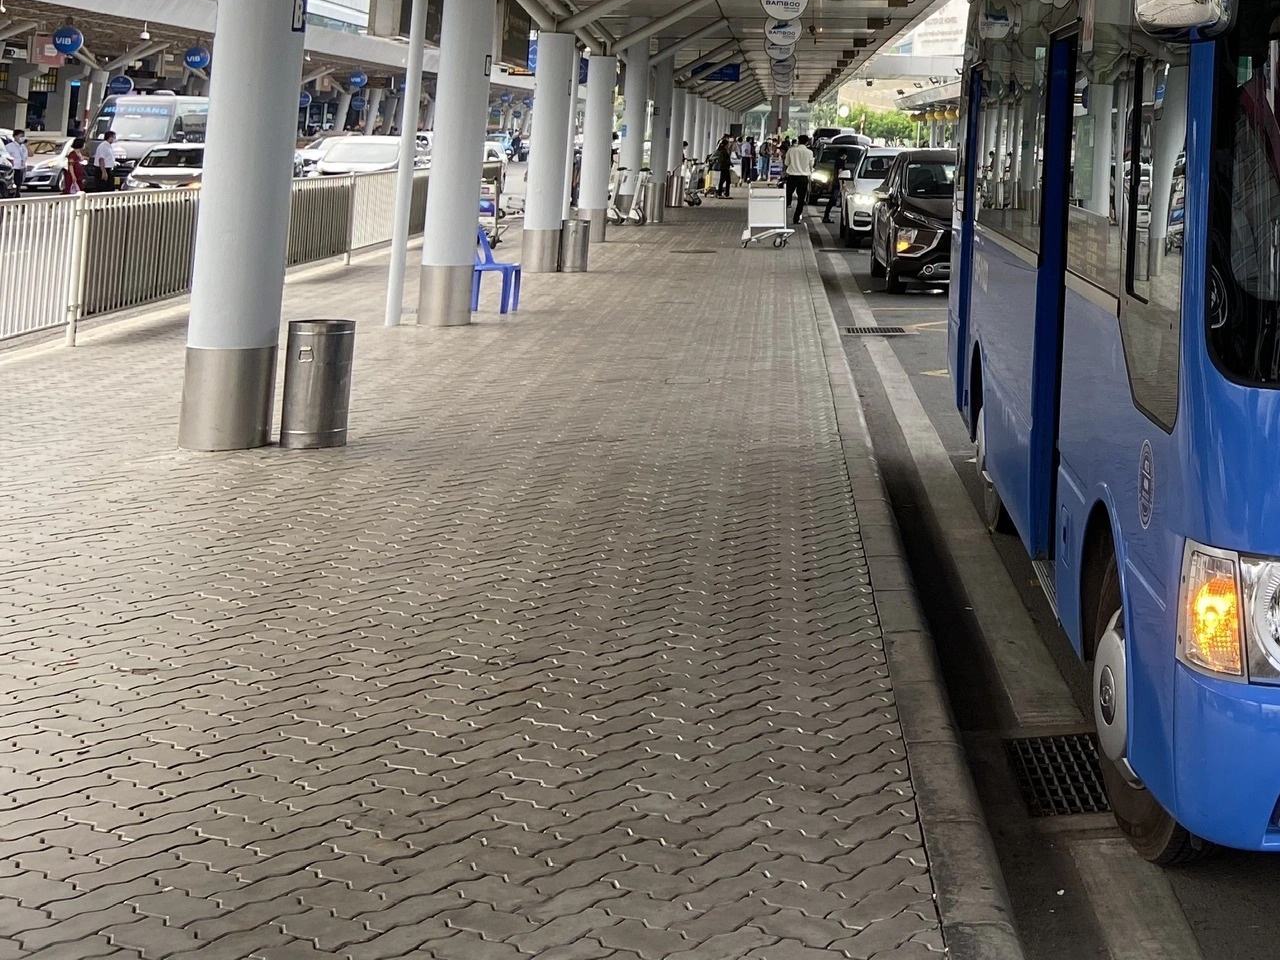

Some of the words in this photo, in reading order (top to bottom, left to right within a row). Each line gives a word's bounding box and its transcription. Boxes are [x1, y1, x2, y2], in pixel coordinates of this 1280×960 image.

[765, 0, 800, 8] BAMBOO
[55, 37, 71, 45] VIB
[186, 54, 201, 62] VIB
